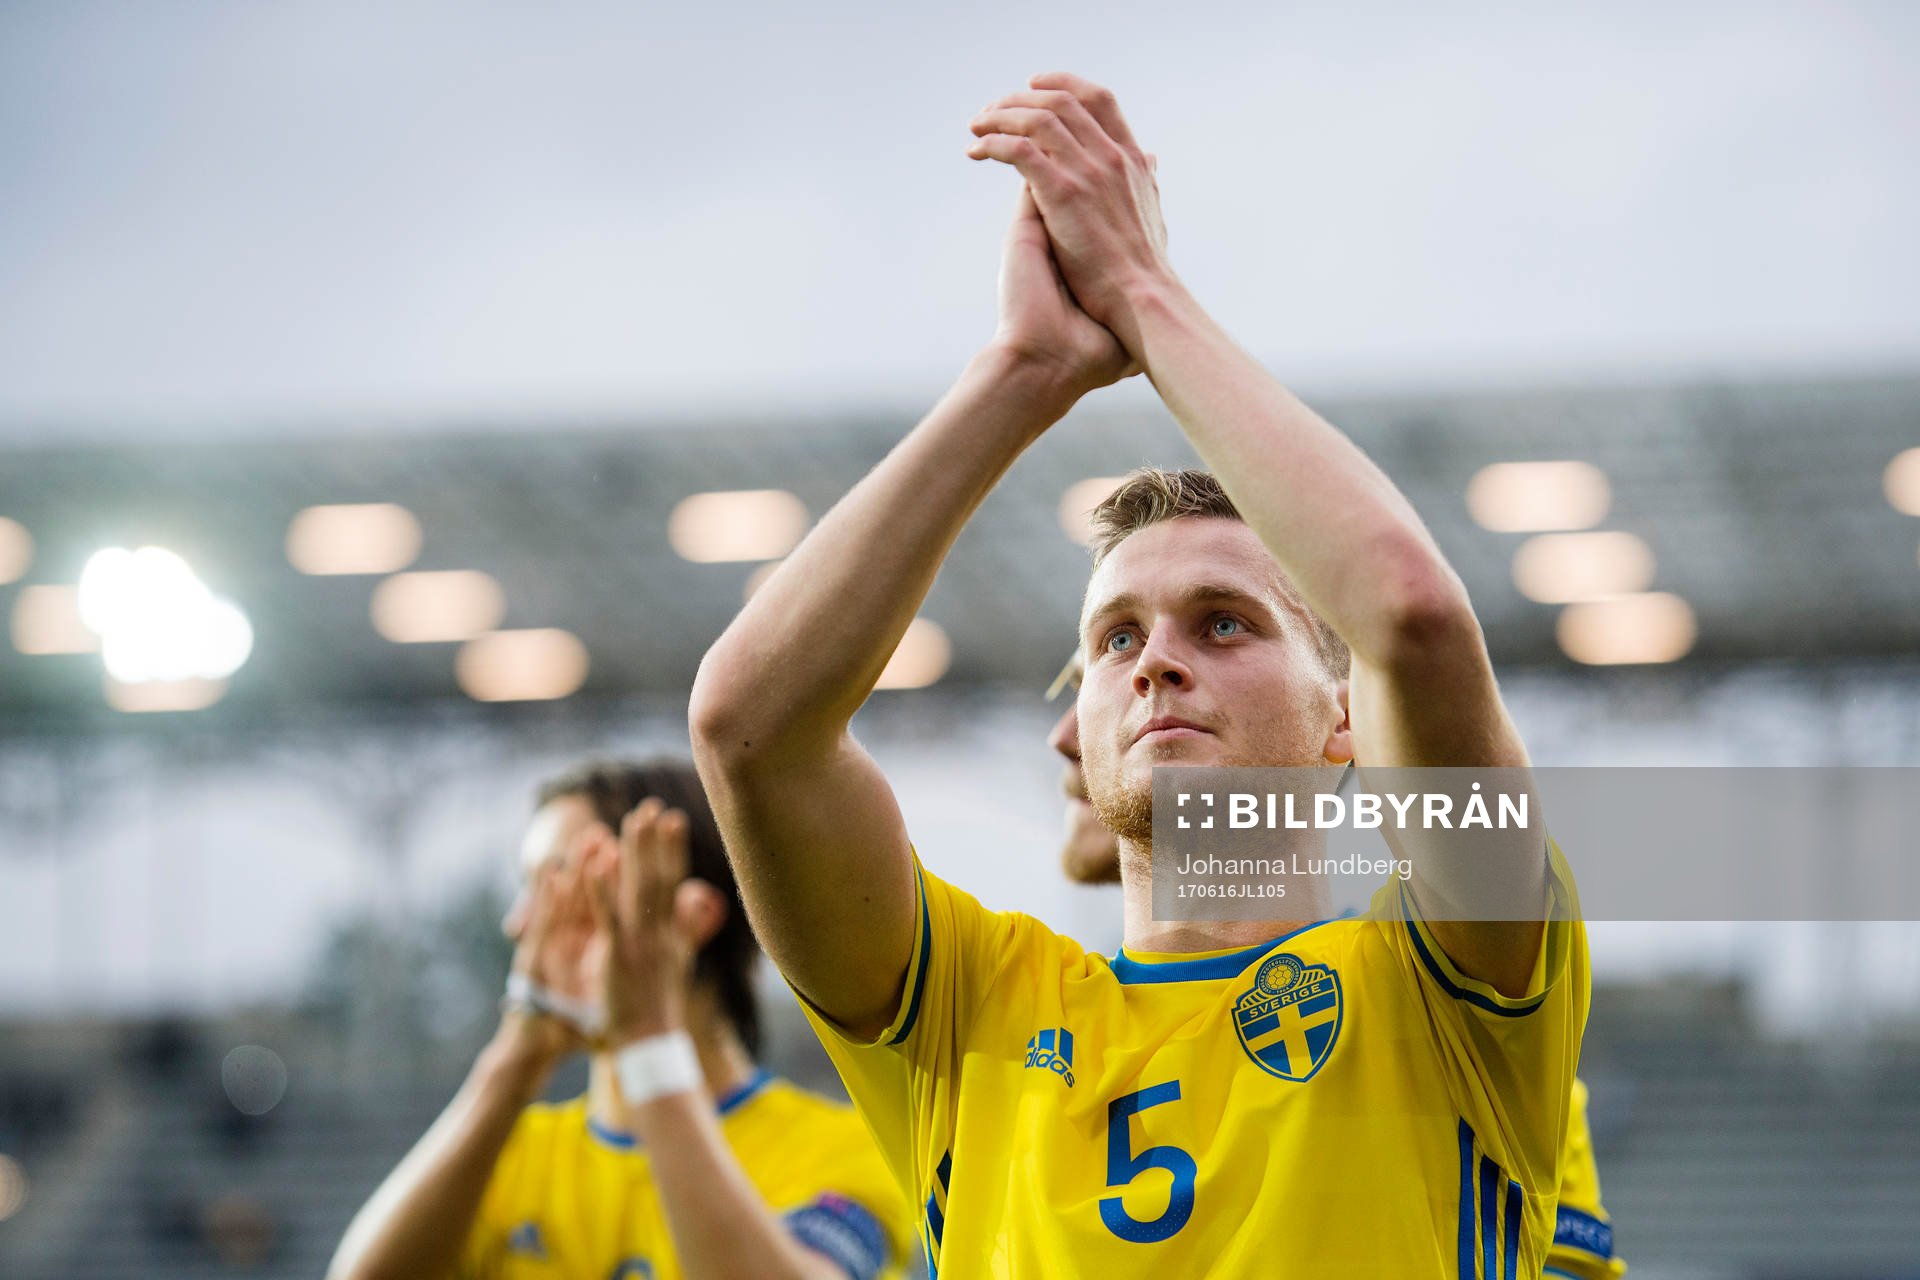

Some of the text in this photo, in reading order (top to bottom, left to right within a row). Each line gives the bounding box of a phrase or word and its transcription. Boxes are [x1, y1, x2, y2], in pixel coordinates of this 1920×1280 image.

[1249, 983, 1322, 1018] SVERIGE
[1024, 1047, 1075, 1088] didas
[1098, 1079, 1197, 1243] 5
